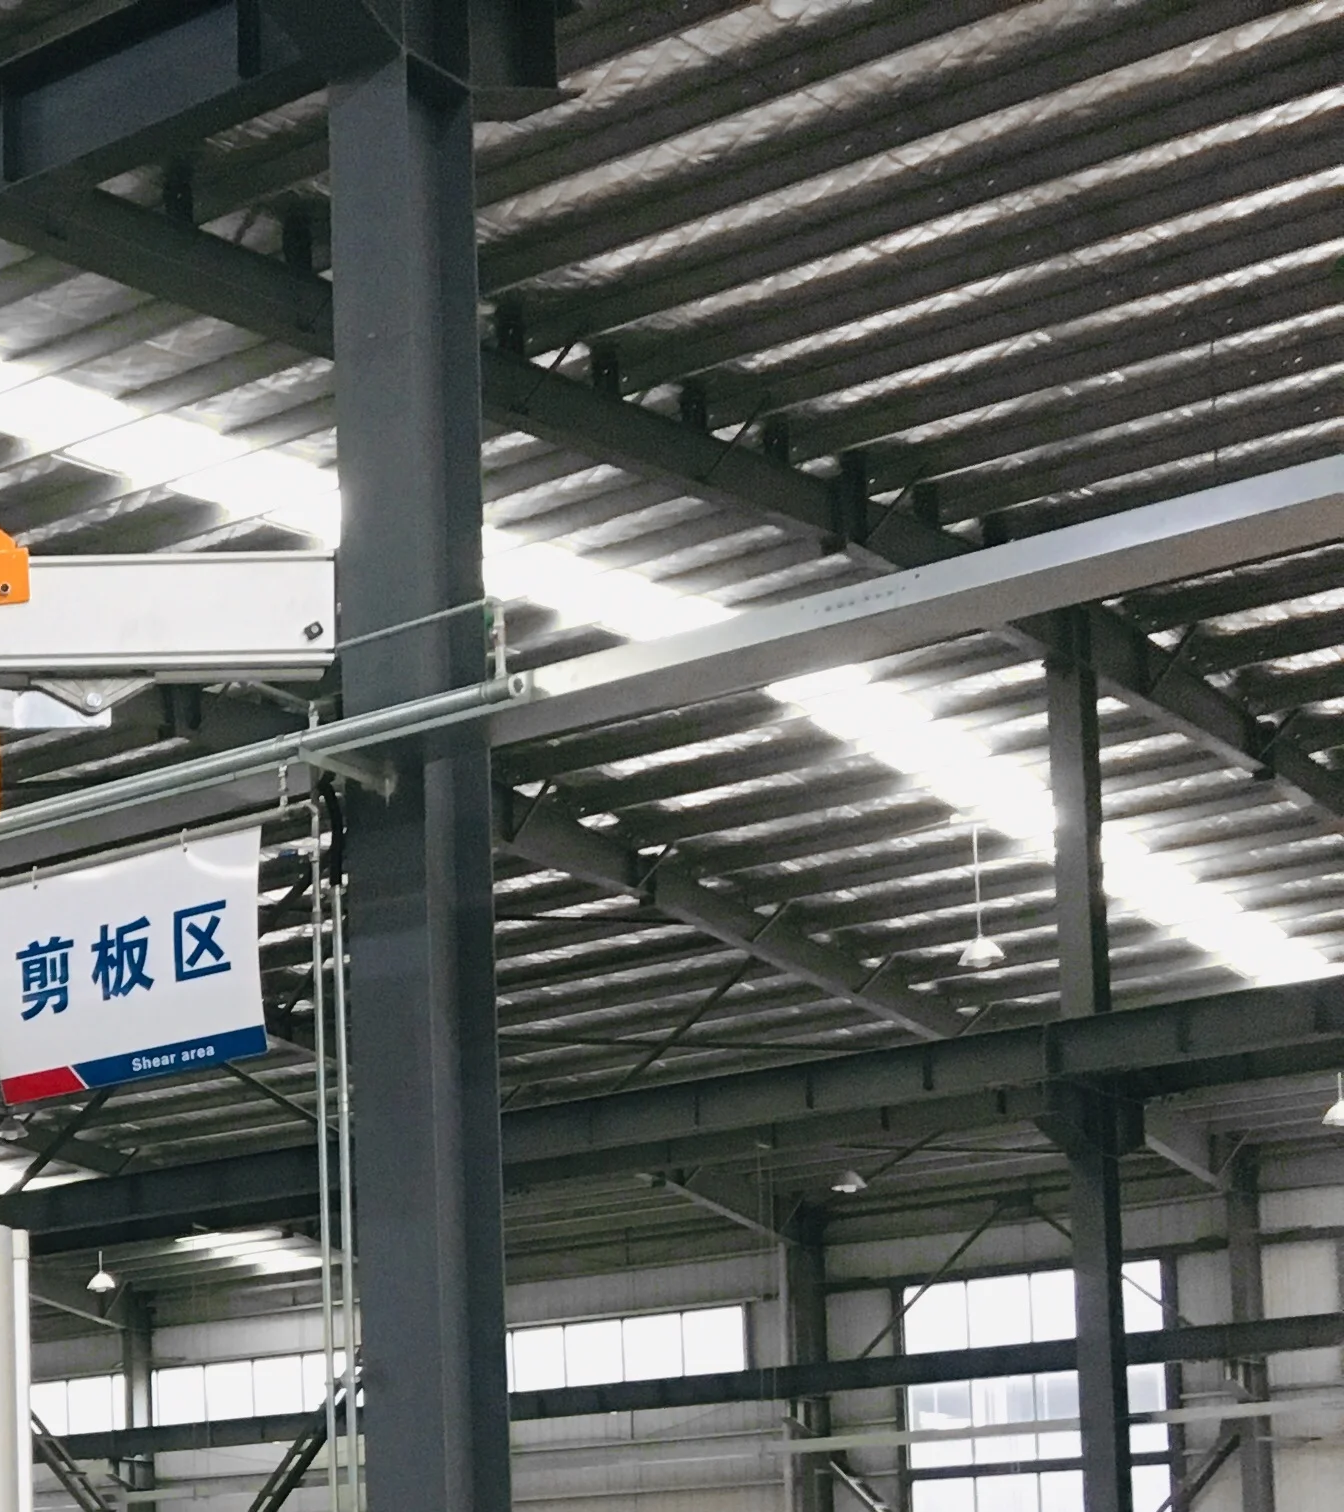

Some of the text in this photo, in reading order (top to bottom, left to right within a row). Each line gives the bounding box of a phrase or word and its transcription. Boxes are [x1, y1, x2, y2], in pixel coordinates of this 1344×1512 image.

[16, 899, 232, 1021] 剪板区
[131, 1045, 215, 1072] Shear area
